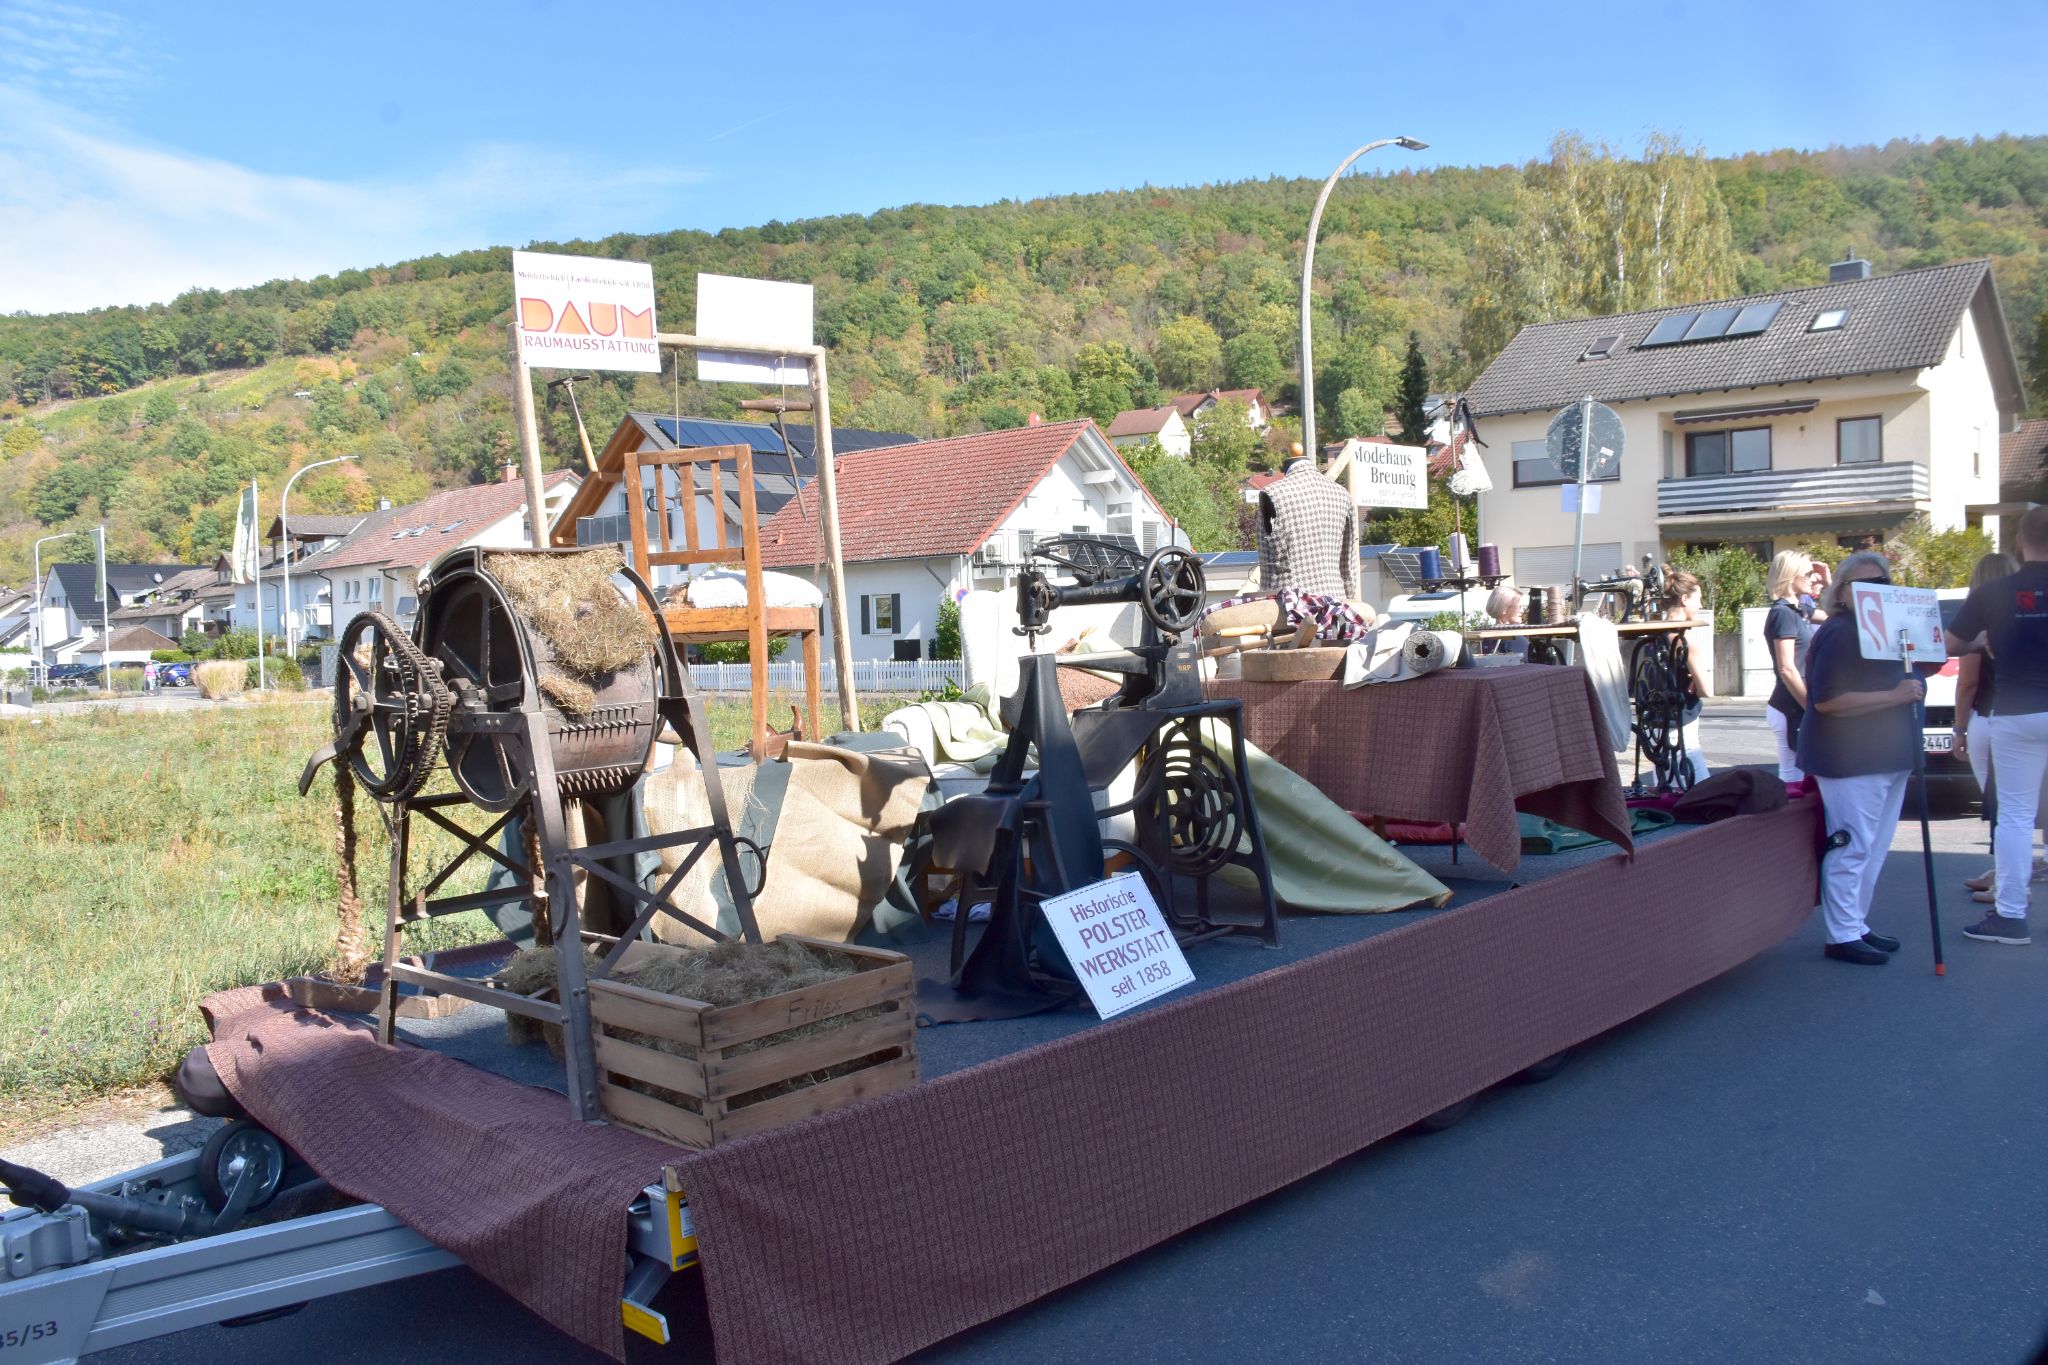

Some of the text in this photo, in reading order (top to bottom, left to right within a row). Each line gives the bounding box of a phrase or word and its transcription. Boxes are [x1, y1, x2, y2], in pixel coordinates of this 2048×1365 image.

[520, 297, 654, 340] DAUM
[524, 335, 656, 354] RAUMAUSSTATTUNG
[1370, 466, 1416, 490] Breunig
[1893, 589, 1936, 606] Schwanen
[1069, 889, 1137, 923] Historische
[1078, 908, 1151, 950] POLSTER
[1079, 930, 1170, 979] WERKSTATT
[1111, 960, 1172, 998] seit 1858
